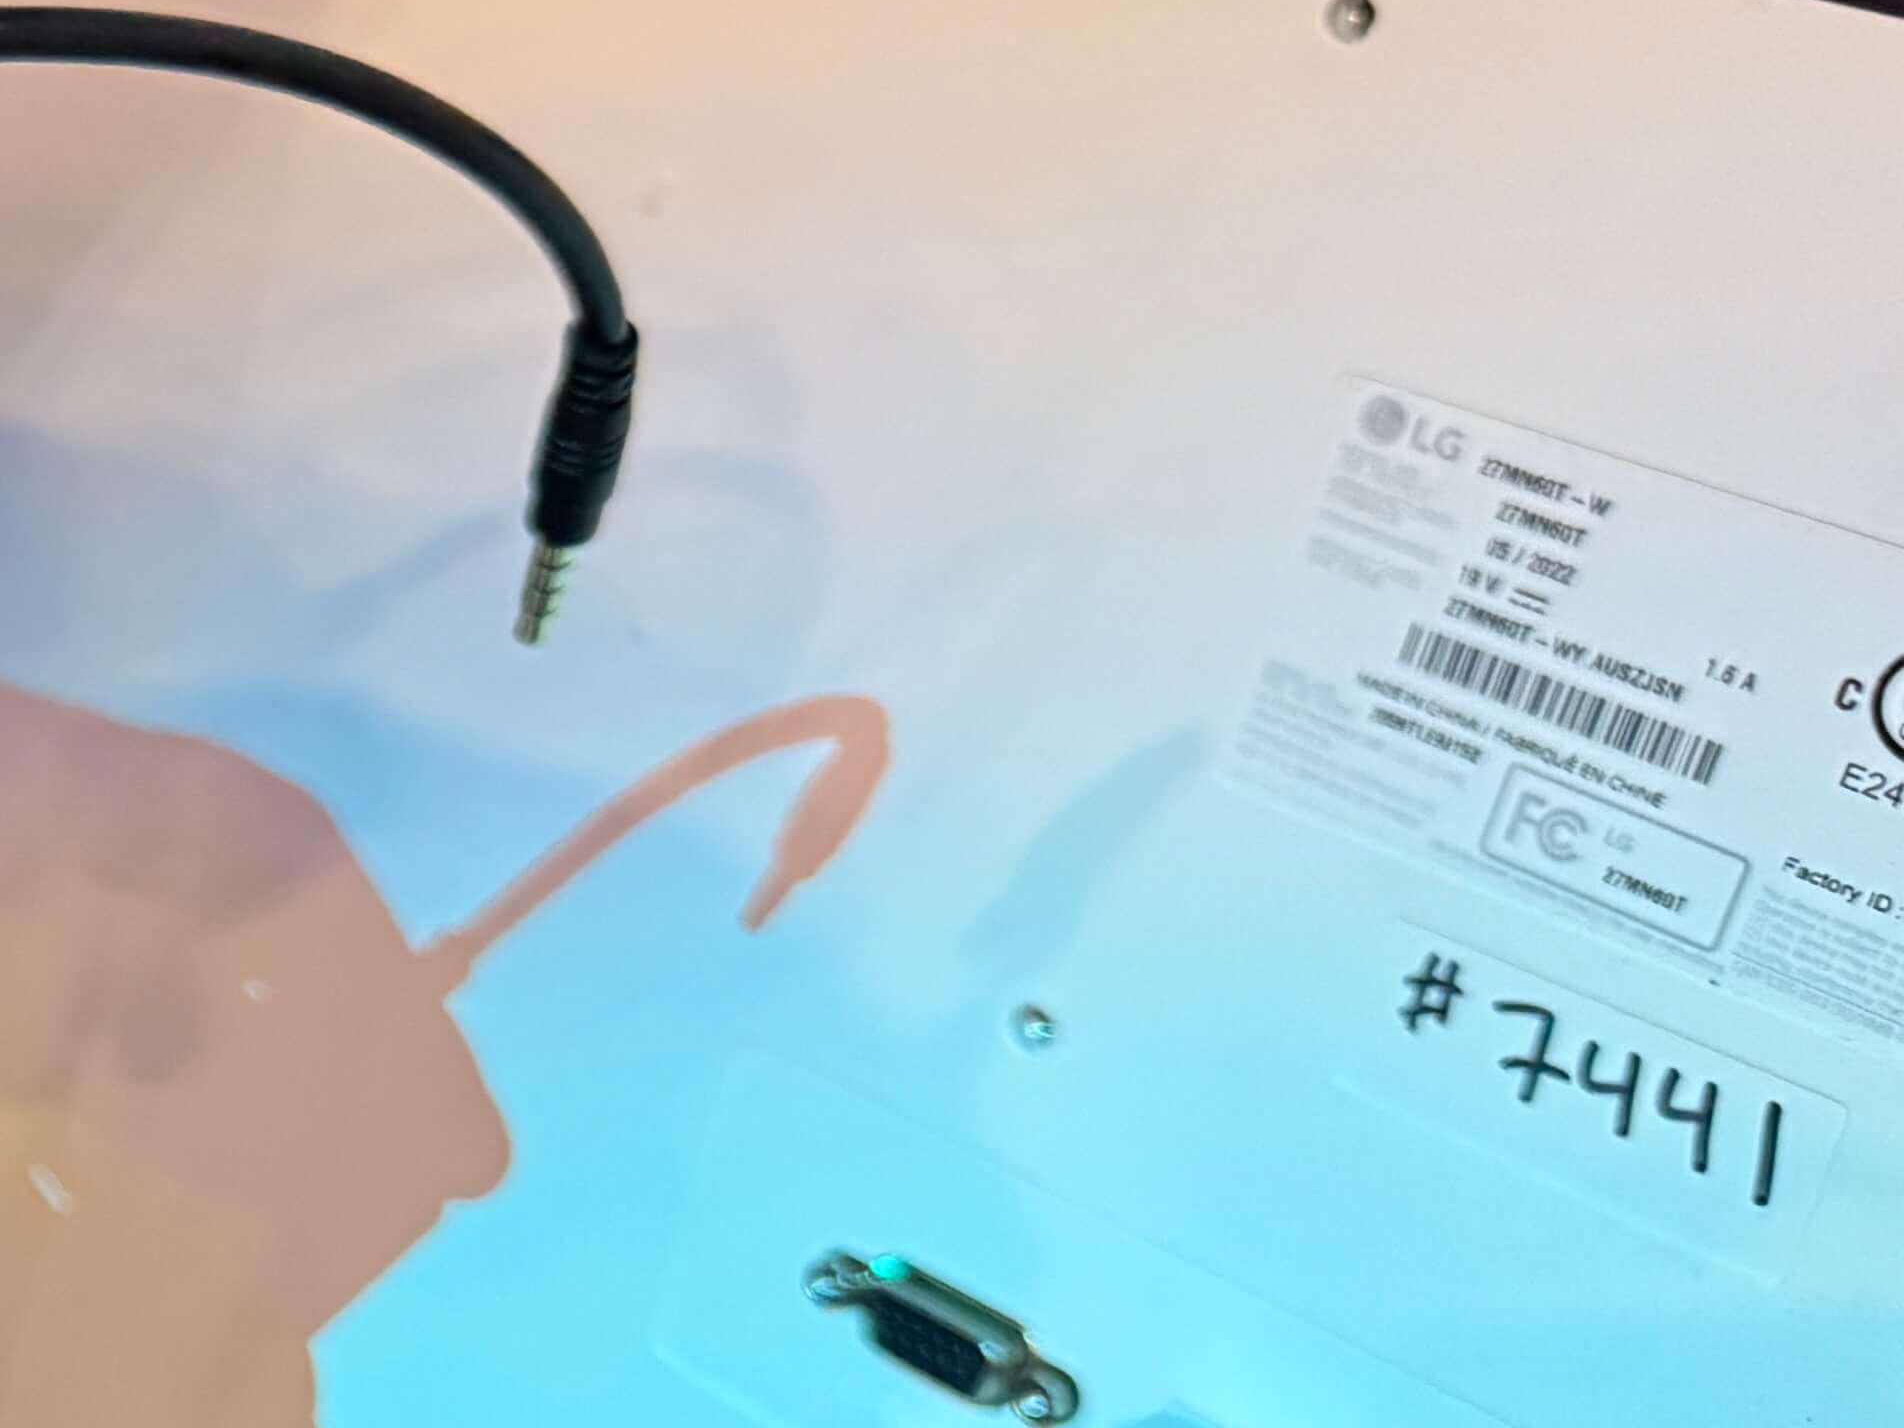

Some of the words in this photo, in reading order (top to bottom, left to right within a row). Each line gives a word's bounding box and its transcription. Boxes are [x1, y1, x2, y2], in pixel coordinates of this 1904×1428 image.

[1410, 414, 1469, 462] LG
[1738, 672, 1756, 693] A
[1781, 856, 1864, 904] Factory
[1866, 892, 1893, 913] ID
